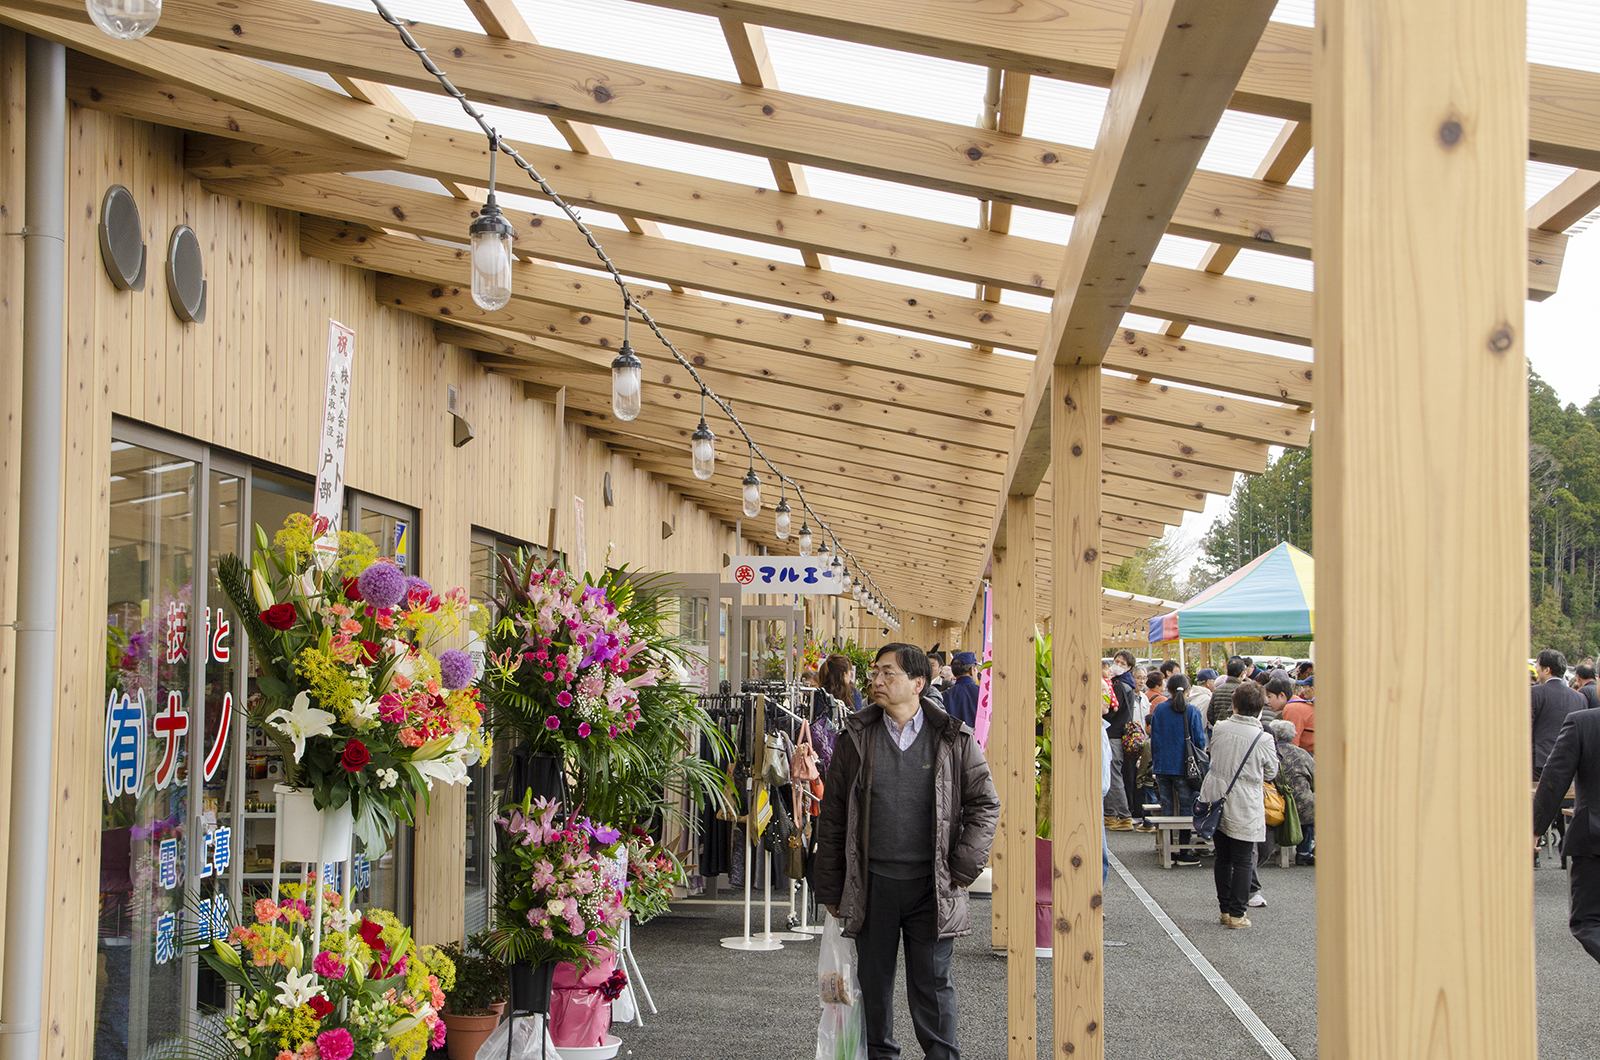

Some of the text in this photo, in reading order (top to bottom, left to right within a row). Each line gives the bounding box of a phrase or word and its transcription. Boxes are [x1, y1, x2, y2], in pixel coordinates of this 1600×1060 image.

[336, 330, 349, 357] 祝
[759, 566, 833, 584] マルエー
[166, 601, 230, 665] 技と
[159, 826, 231, 890] 電工事
